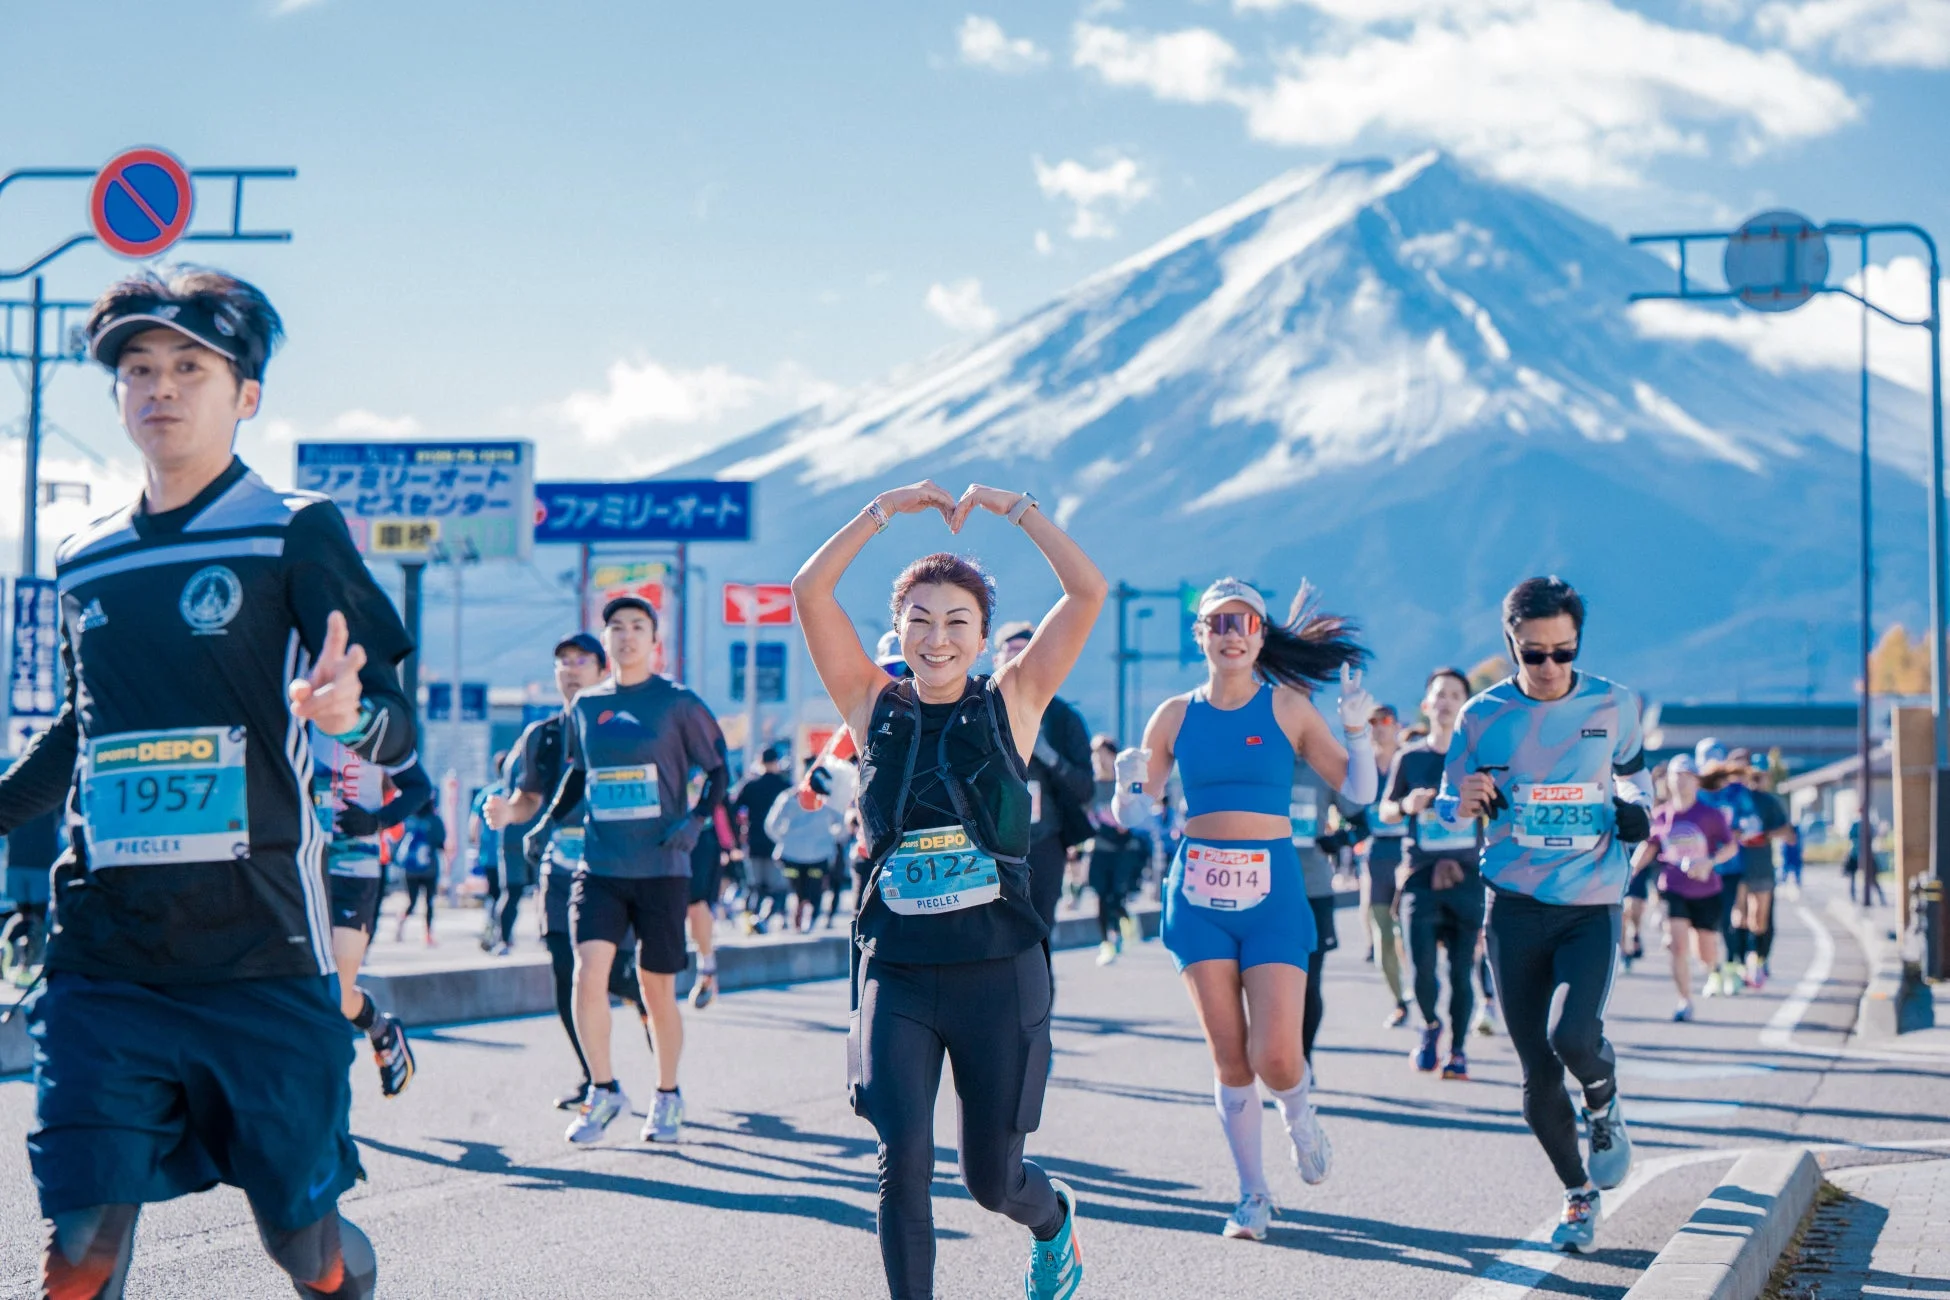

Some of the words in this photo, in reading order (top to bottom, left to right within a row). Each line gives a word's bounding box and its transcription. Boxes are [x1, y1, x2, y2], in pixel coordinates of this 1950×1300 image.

[304, 468, 511, 490] ファミリーオート
[338, 493, 510, 516] ービスセンター
[551, 493, 742, 530] ファミリーオート
[138, 738, 214, 762] DEPO
[115, 773, 218, 815] 1957
[1534, 804, 1594, 826] 2235
[900, 839, 919, 849] PORTS
[919, 832, 966, 850] DEPO
[905, 855, 980, 884] 6122
[1205, 867, 1259, 888] 6014
[916, 894, 960, 910] PIECLEX
